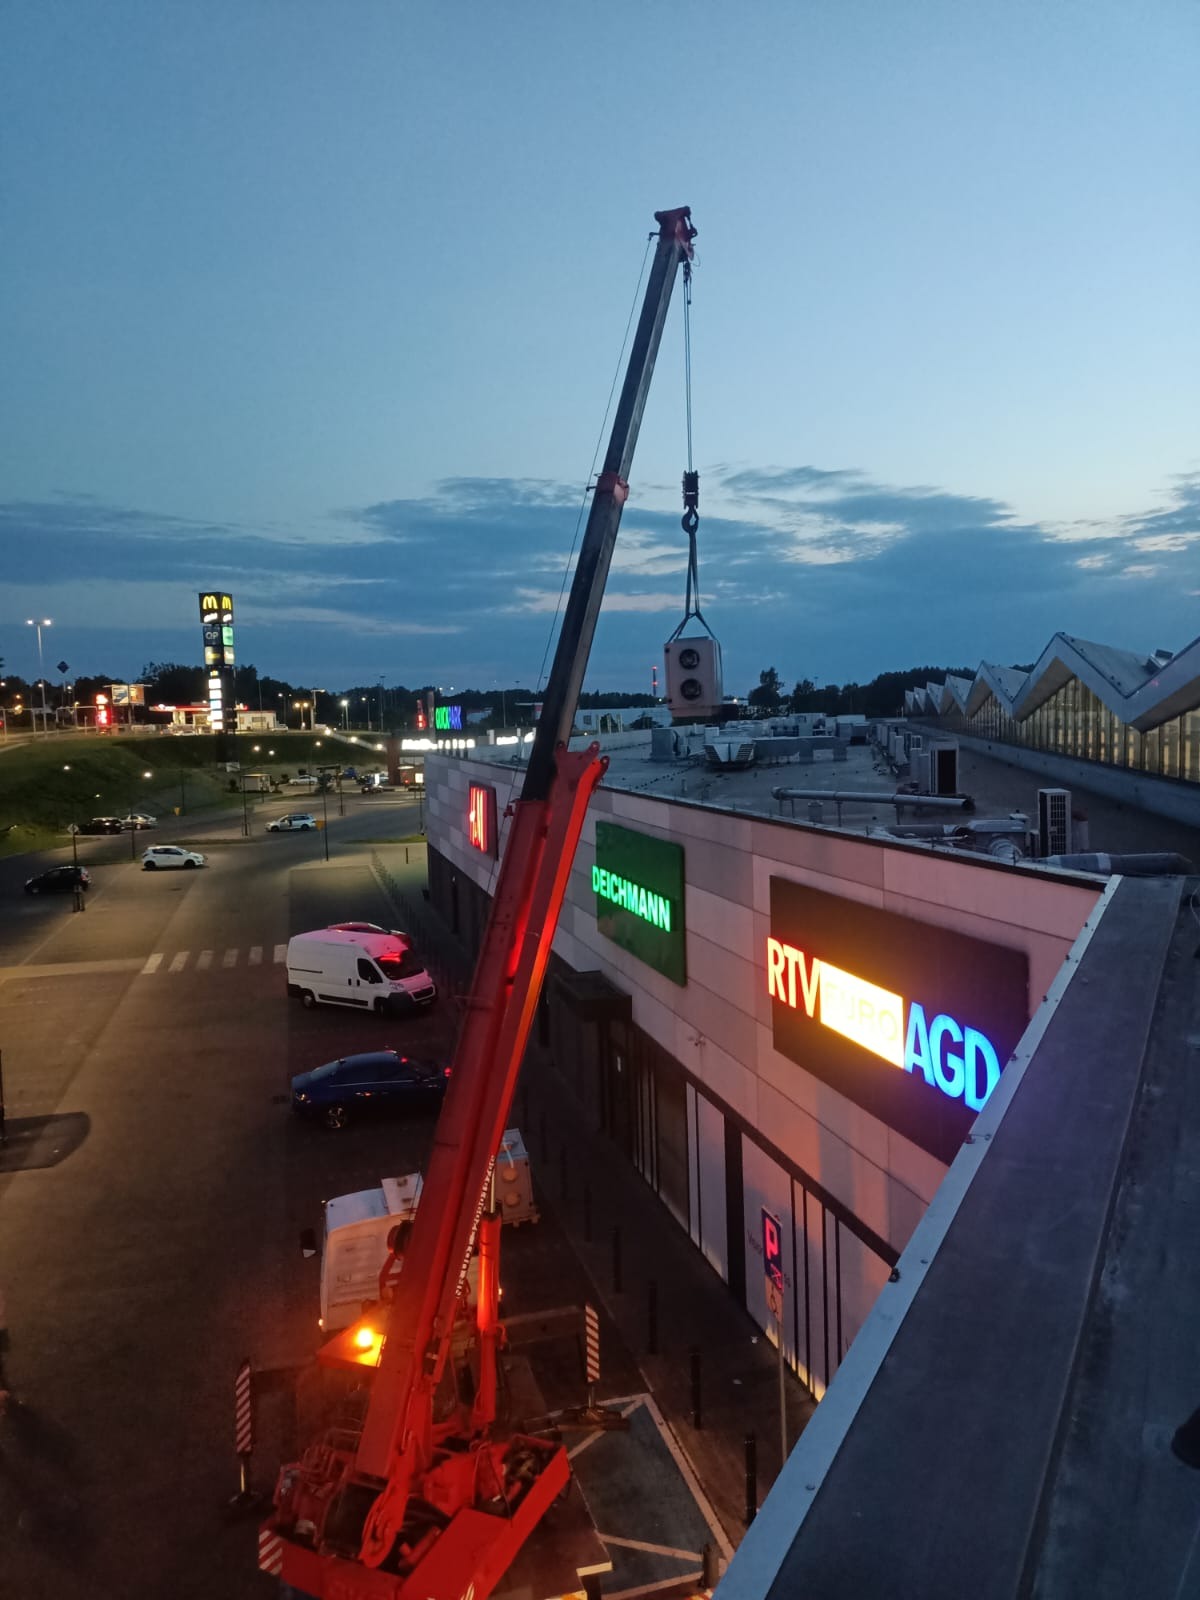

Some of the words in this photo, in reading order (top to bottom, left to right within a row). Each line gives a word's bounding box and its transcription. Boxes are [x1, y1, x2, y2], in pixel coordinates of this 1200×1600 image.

[592, 864, 671, 933] DEICHMANN
[767, 937, 820, 1018] RTV
[824, 980, 898, 1041] EURO
[904, 1001, 1001, 1113] AGD
[765, 1217, 779, 1260] P
